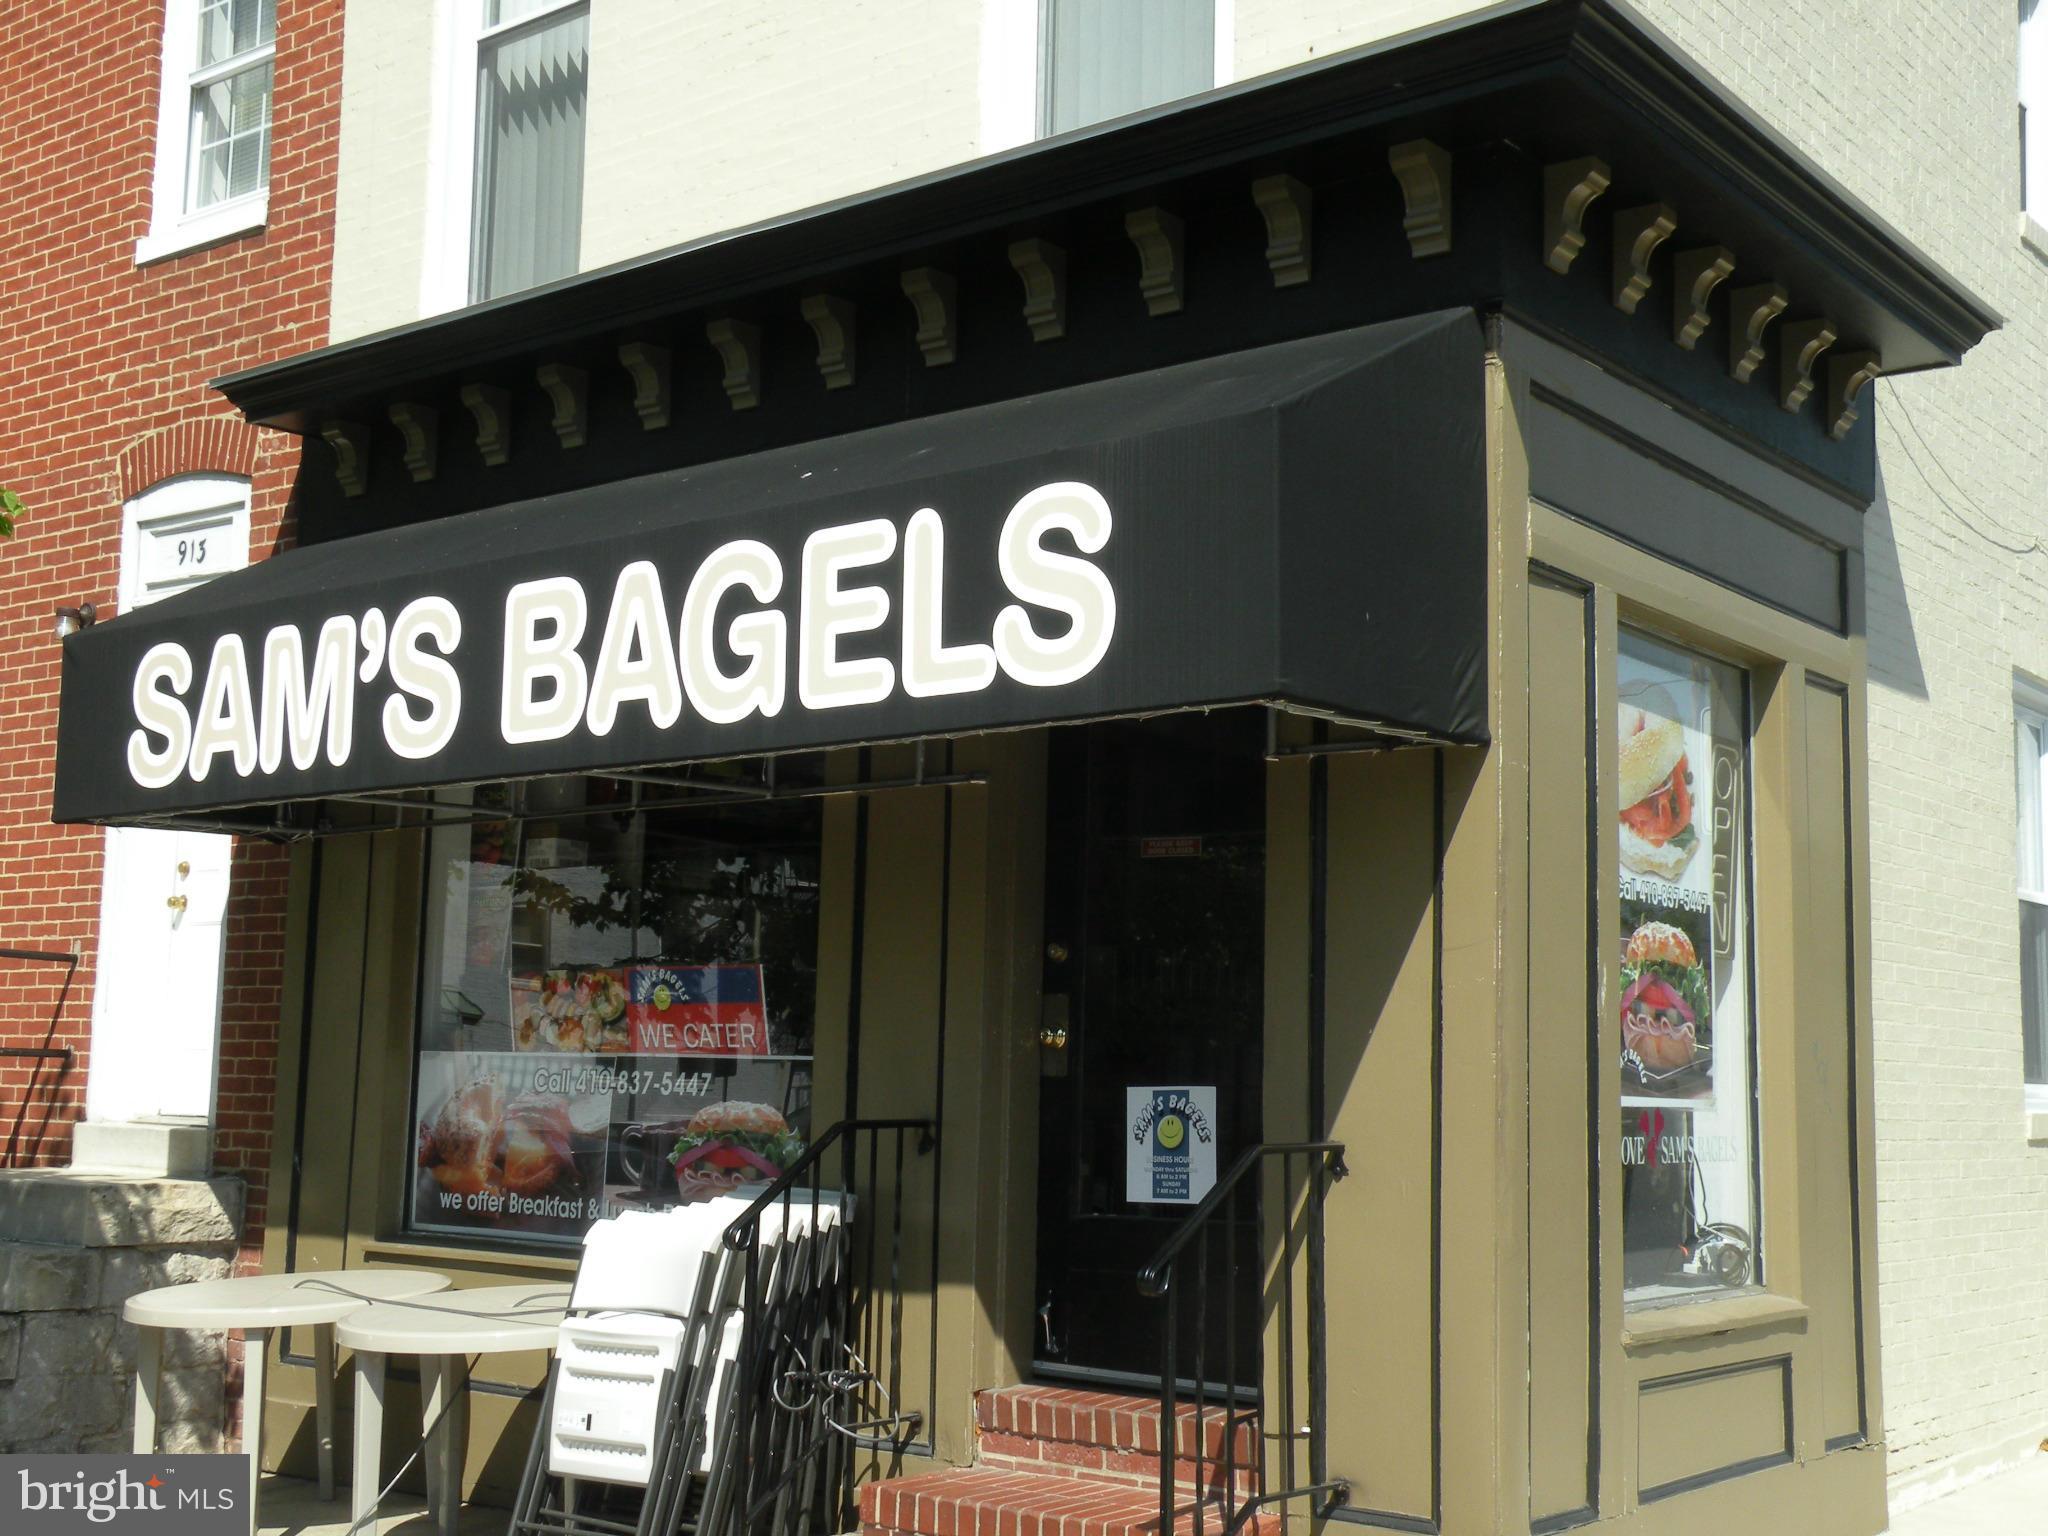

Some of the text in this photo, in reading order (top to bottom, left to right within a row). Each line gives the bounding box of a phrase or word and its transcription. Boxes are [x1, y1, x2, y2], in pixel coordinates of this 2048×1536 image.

[127, 481, 1117, 790] SAM'S BAGELS
[1639, 880, 1708, 914] 410-837-5447
[637, 968, 690, 1003] SAM'S BAGELS
[639, 1023, 757, 1048] WE CATER
[534, 1067, 712, 1097] Call 410-837-5447
[1133, 1094, 1211, 1144] SAM'S BAGELS
[1145, 1155, 1195, 1164] SINESS HOU
[1621, 1136, 1645, 1165] OVE
[1661, 1135, 1694, 1164] SAM'S
[439, 1191, 462, 1210] we
[467, 1190, 504, 1212] offer
[509, 1191, 583, 1219] Breakfast
[587, 1198, 601, 1220] &
[603, 1199, 656, 1220] Luh
